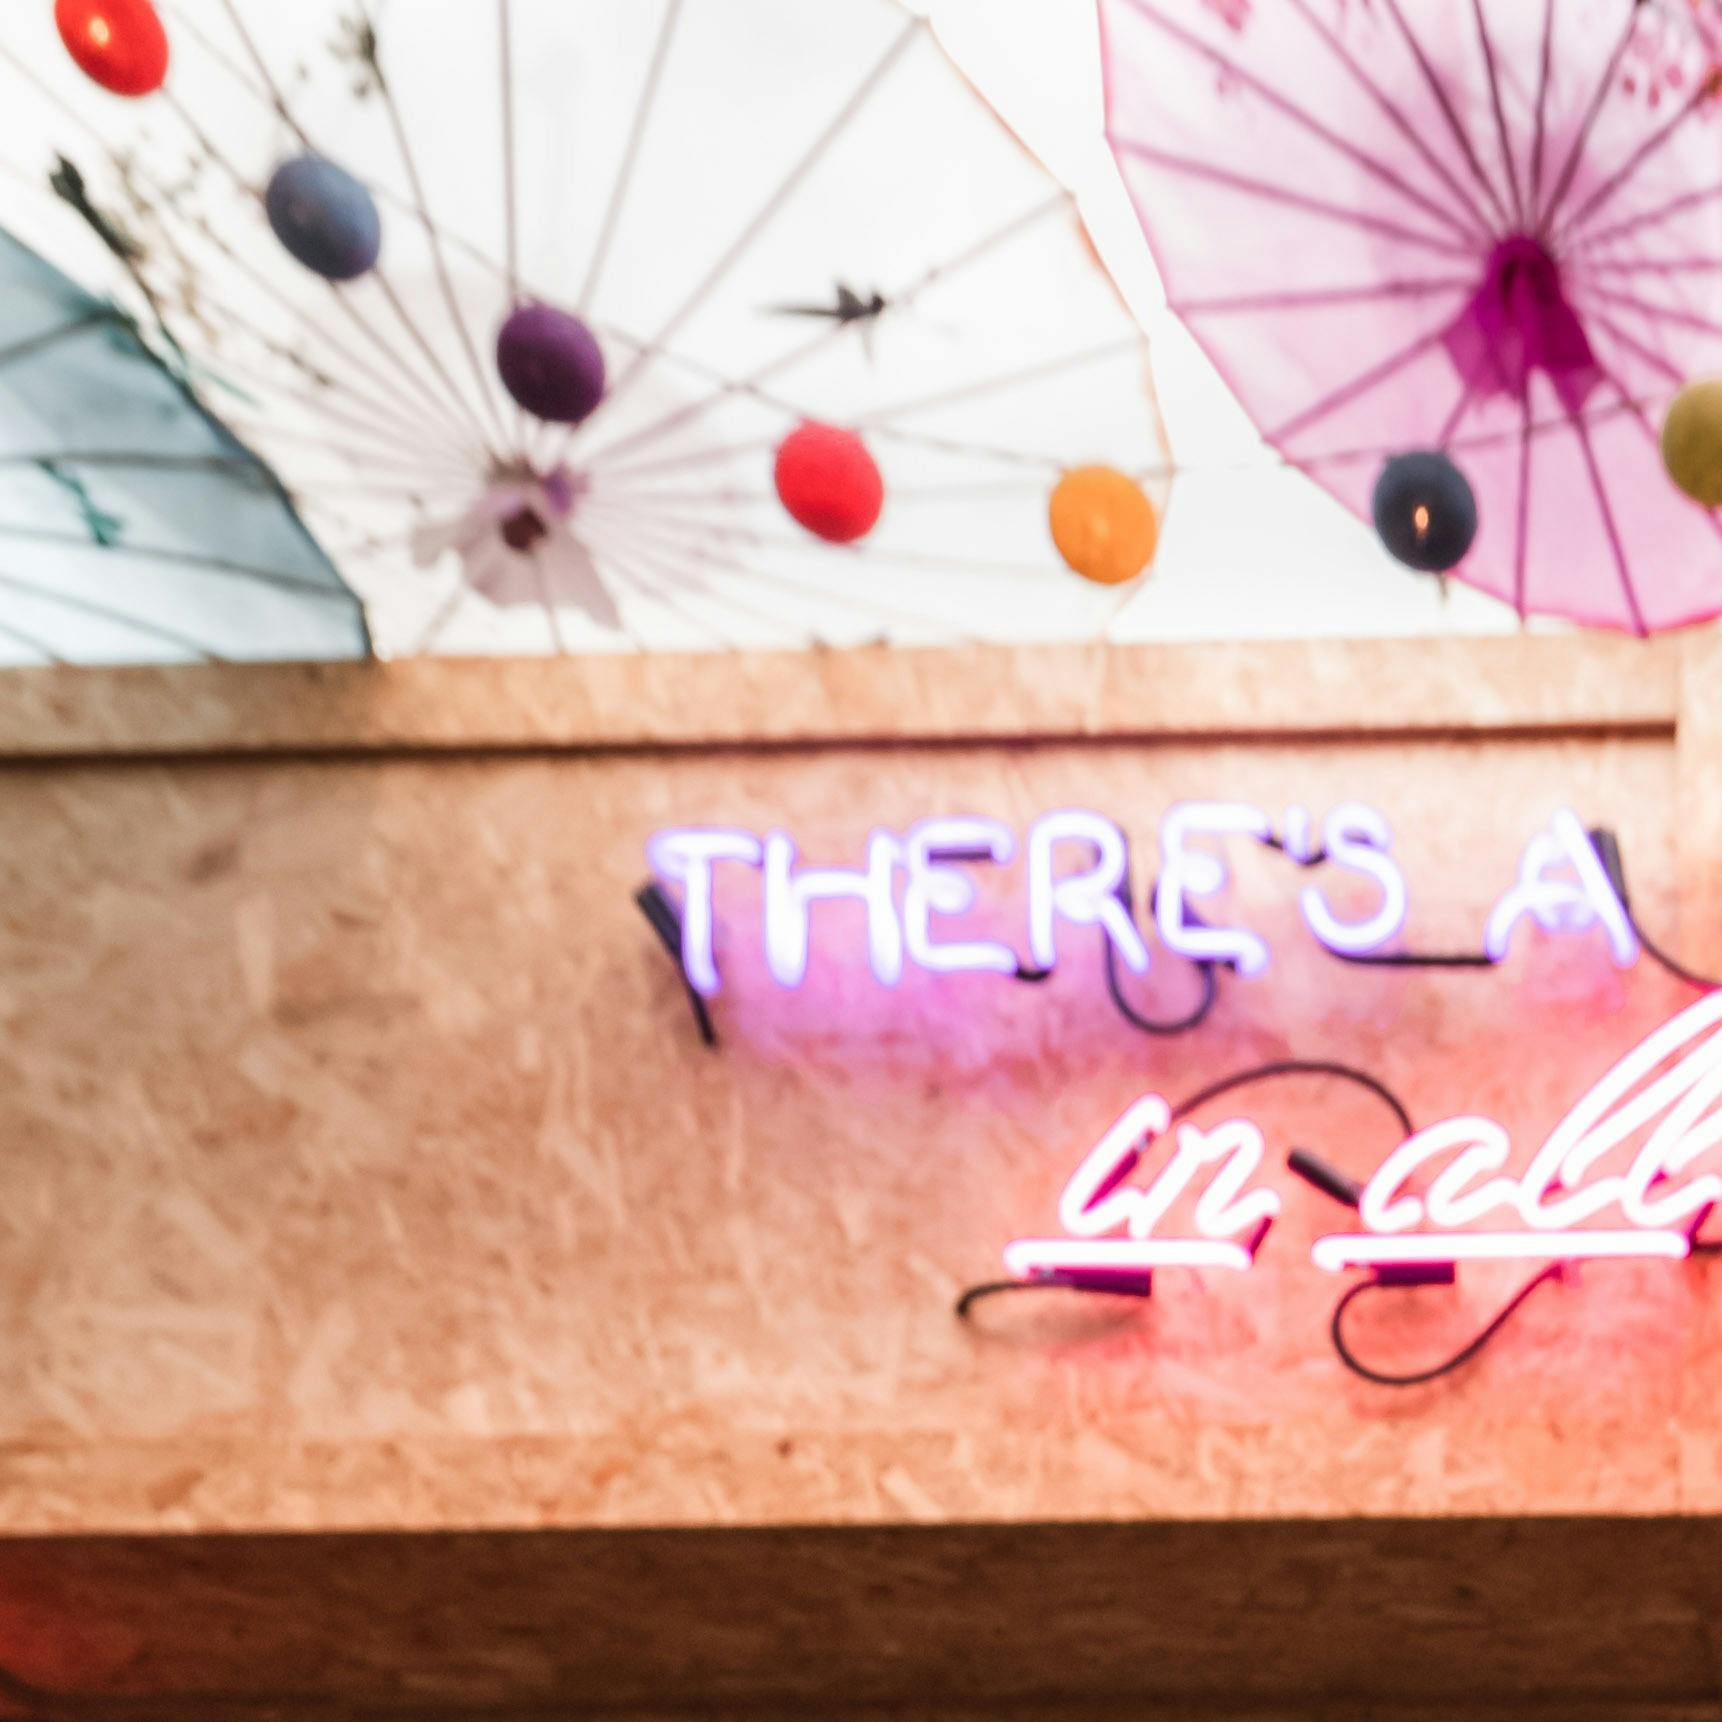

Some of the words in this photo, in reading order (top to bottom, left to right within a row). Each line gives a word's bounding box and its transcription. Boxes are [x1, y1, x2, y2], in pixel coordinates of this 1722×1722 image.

[645, 801, 1407, 993] THERE'S
[1481, 807, 1642, 968] A
[1058, 1094, 1283, 1242] in
